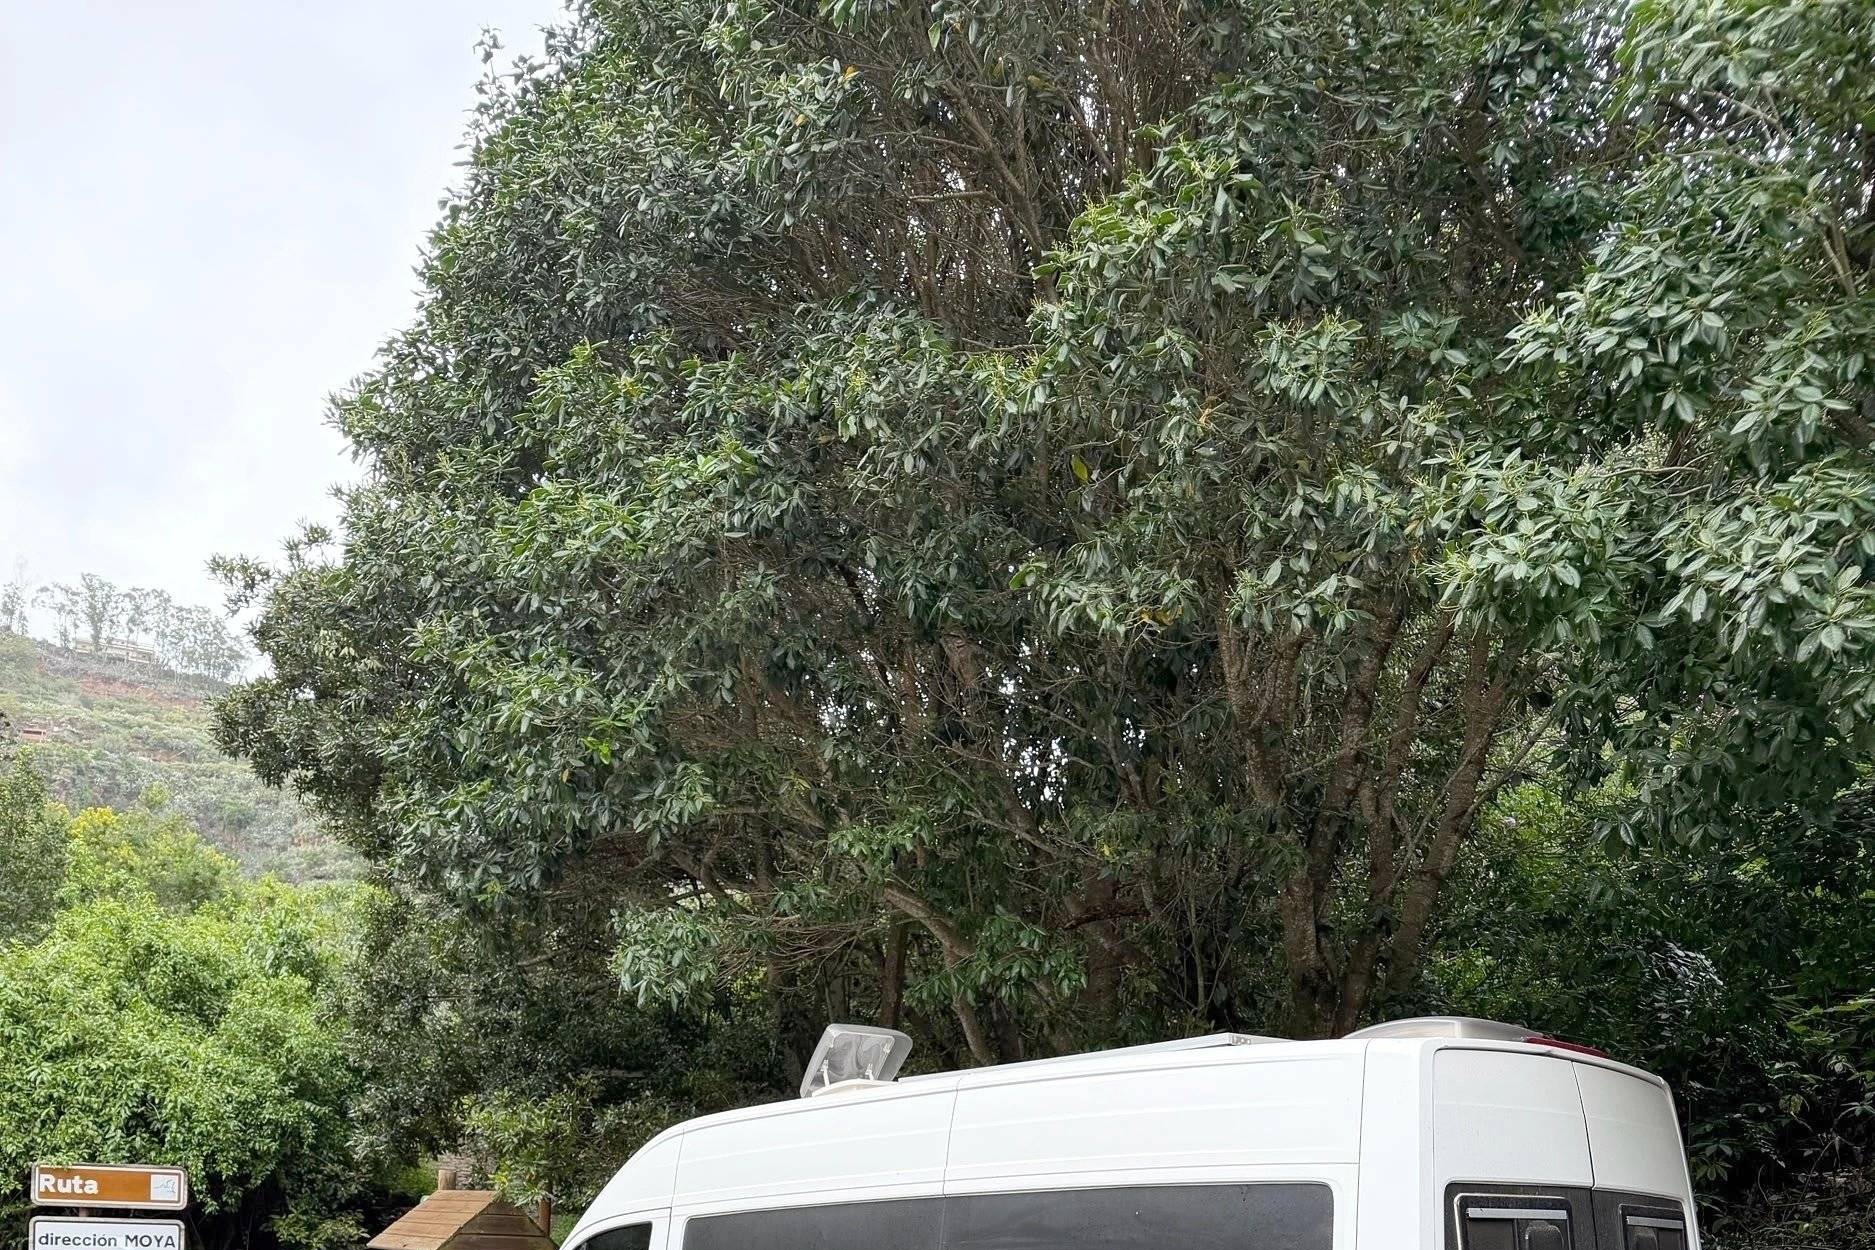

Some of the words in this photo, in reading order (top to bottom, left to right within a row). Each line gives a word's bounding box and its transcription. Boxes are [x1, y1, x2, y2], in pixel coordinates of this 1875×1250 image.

[39, 1173, 99, 1195] Ruta
[38, 1233, 117, 1247] dirección
[125, 1234, 176, 1248] MOYA
